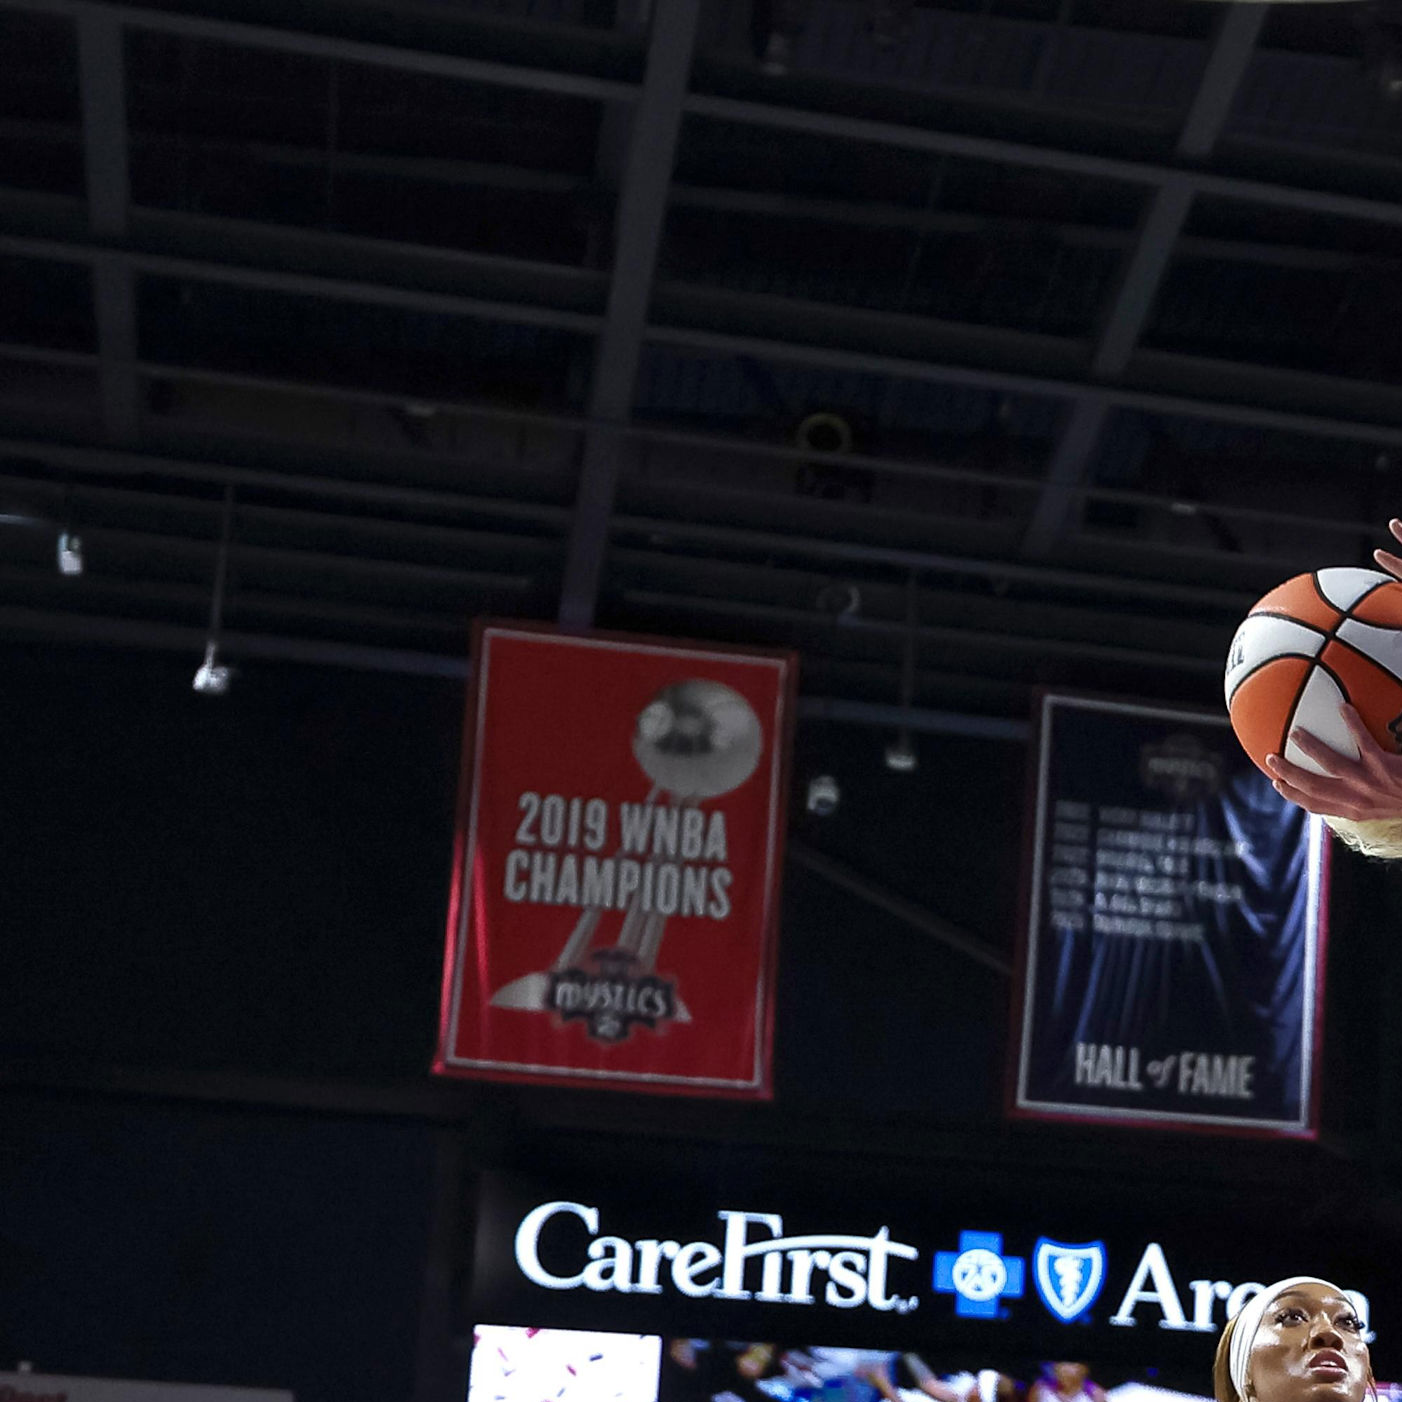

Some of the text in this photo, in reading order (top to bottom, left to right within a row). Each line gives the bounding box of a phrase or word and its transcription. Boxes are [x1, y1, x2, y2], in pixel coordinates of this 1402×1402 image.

[516, 791, 728, 863] 2019 WNBA
[503, 848, 734, 920] CHAMPIONS
[1074, 1041, 1256, 1100] HALL of FAME
